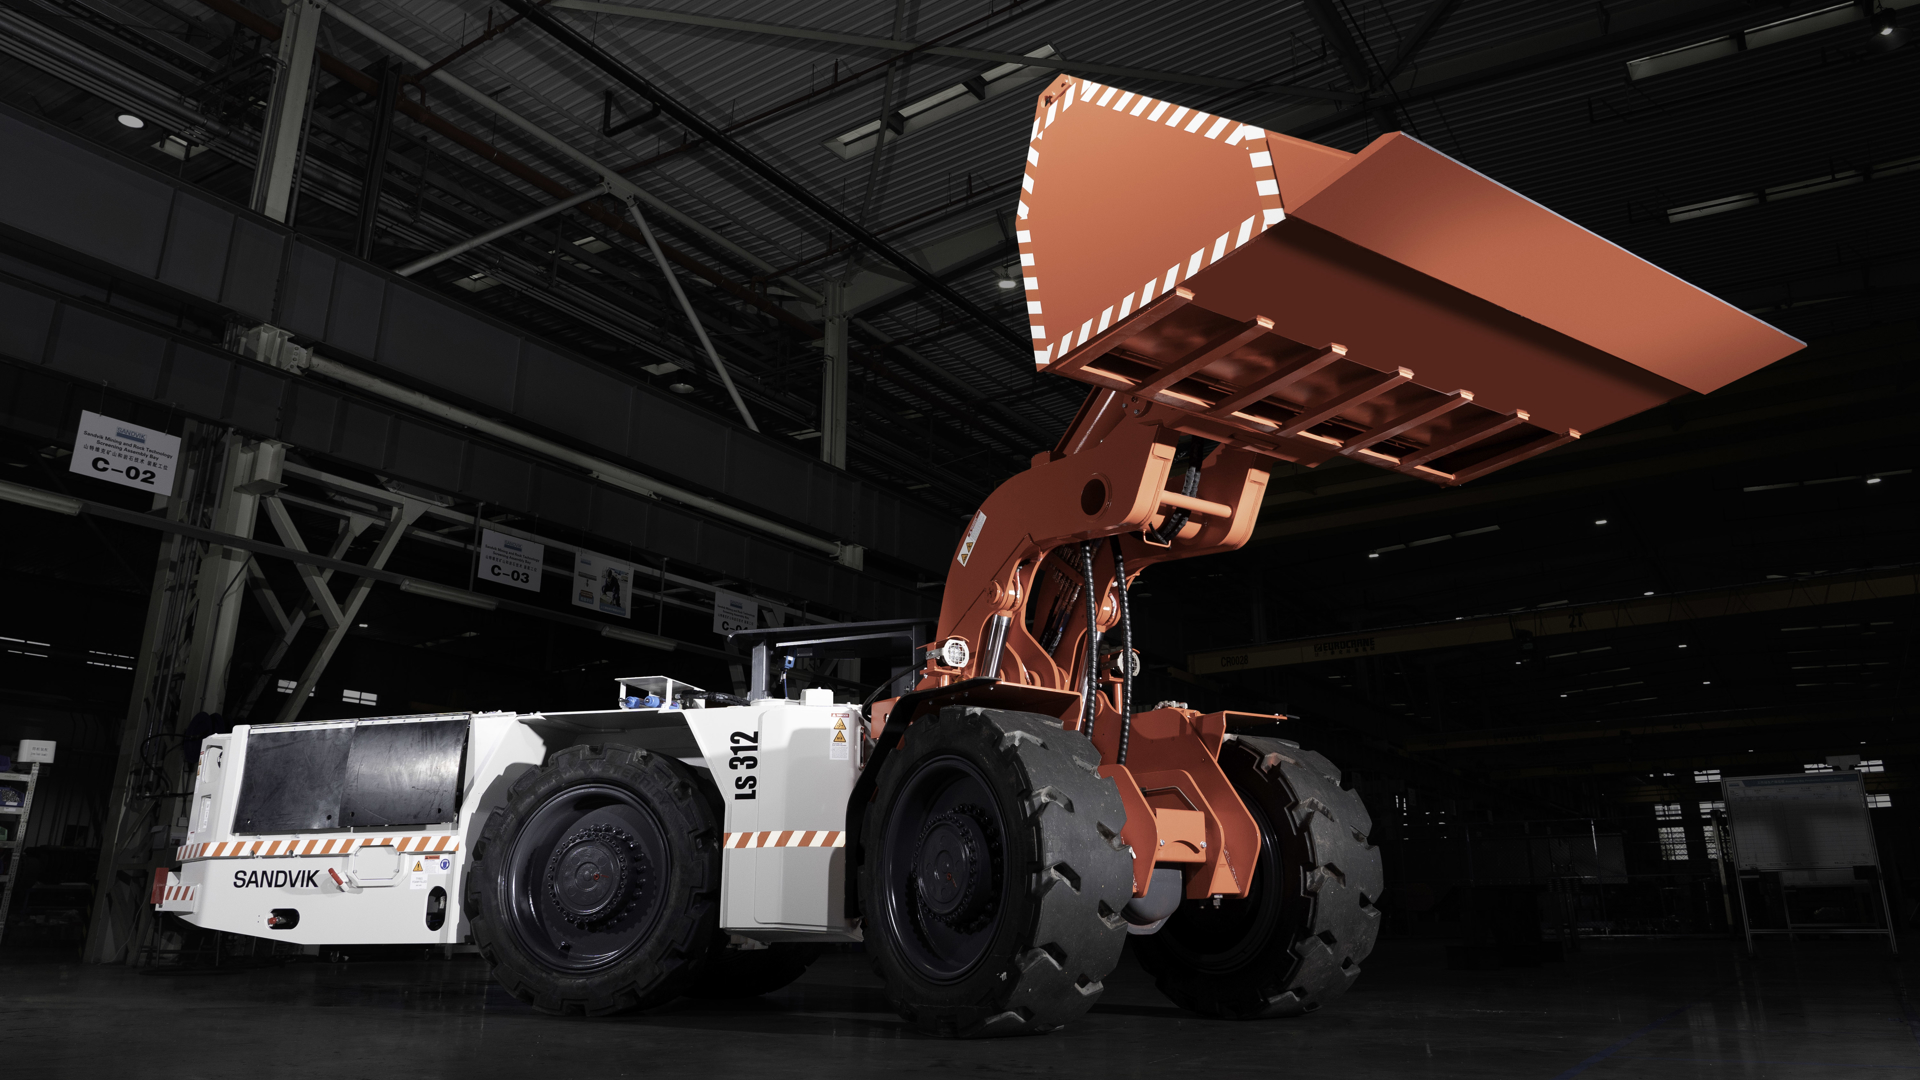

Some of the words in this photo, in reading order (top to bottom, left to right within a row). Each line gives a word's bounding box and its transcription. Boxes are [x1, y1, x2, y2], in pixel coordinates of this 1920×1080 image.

[117, 427, 146, 440] SANDVIK
[83, 430, 104, 440] Sandvik
[105, 436, 122, 446] Mining
[133, 443, 145, 451] Rock
[146, 447, 173, 459] Technology
[96, 440, 123, 451] Screening
[124, 447, 148, 458] Assembly
[91, 456, 156, 485] C-02
[490, 564, 530, 584] C-03
[1568, 613, 1583, 628] 2T
[1323, 637, 1375, 652] EUROCRANE
[1220, 654, 1249, 668] CR0028
[728, 731, 759, 770] 312
[734, 775, 757, 800] LS
[233, 869, 320, 888] SANDVIK
